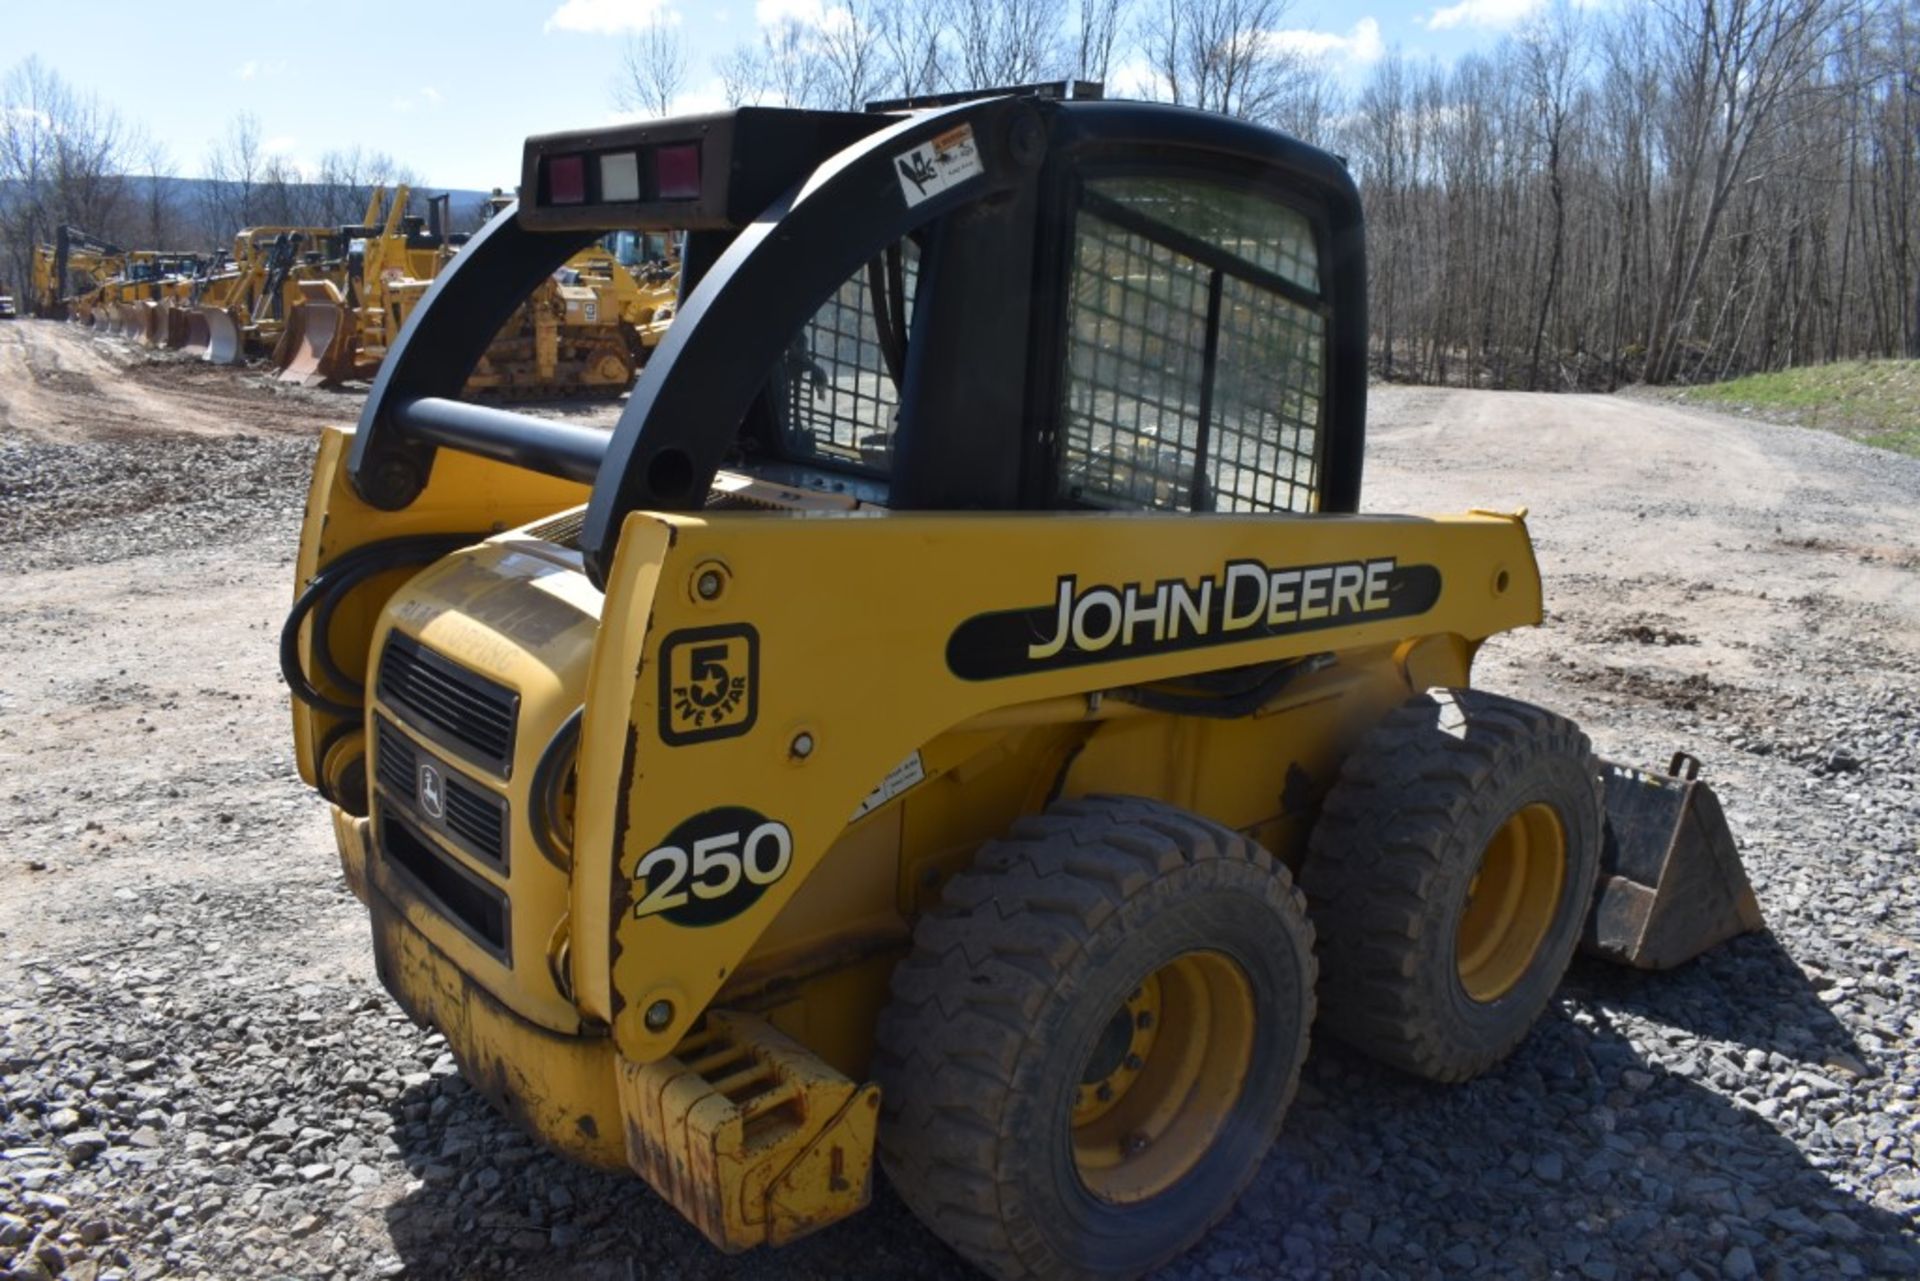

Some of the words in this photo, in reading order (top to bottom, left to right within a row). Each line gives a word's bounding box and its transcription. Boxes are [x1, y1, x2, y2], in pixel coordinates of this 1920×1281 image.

[1028, 576, 1212, 660] JOHN
[1221, 560, 1395, 632] DEERE
[673, 687, 706, 727] FIVE
[710, 676, 745, 723] STAR
[690, 644, 730, 707] 5
[636, 821, 792, 917] 250
